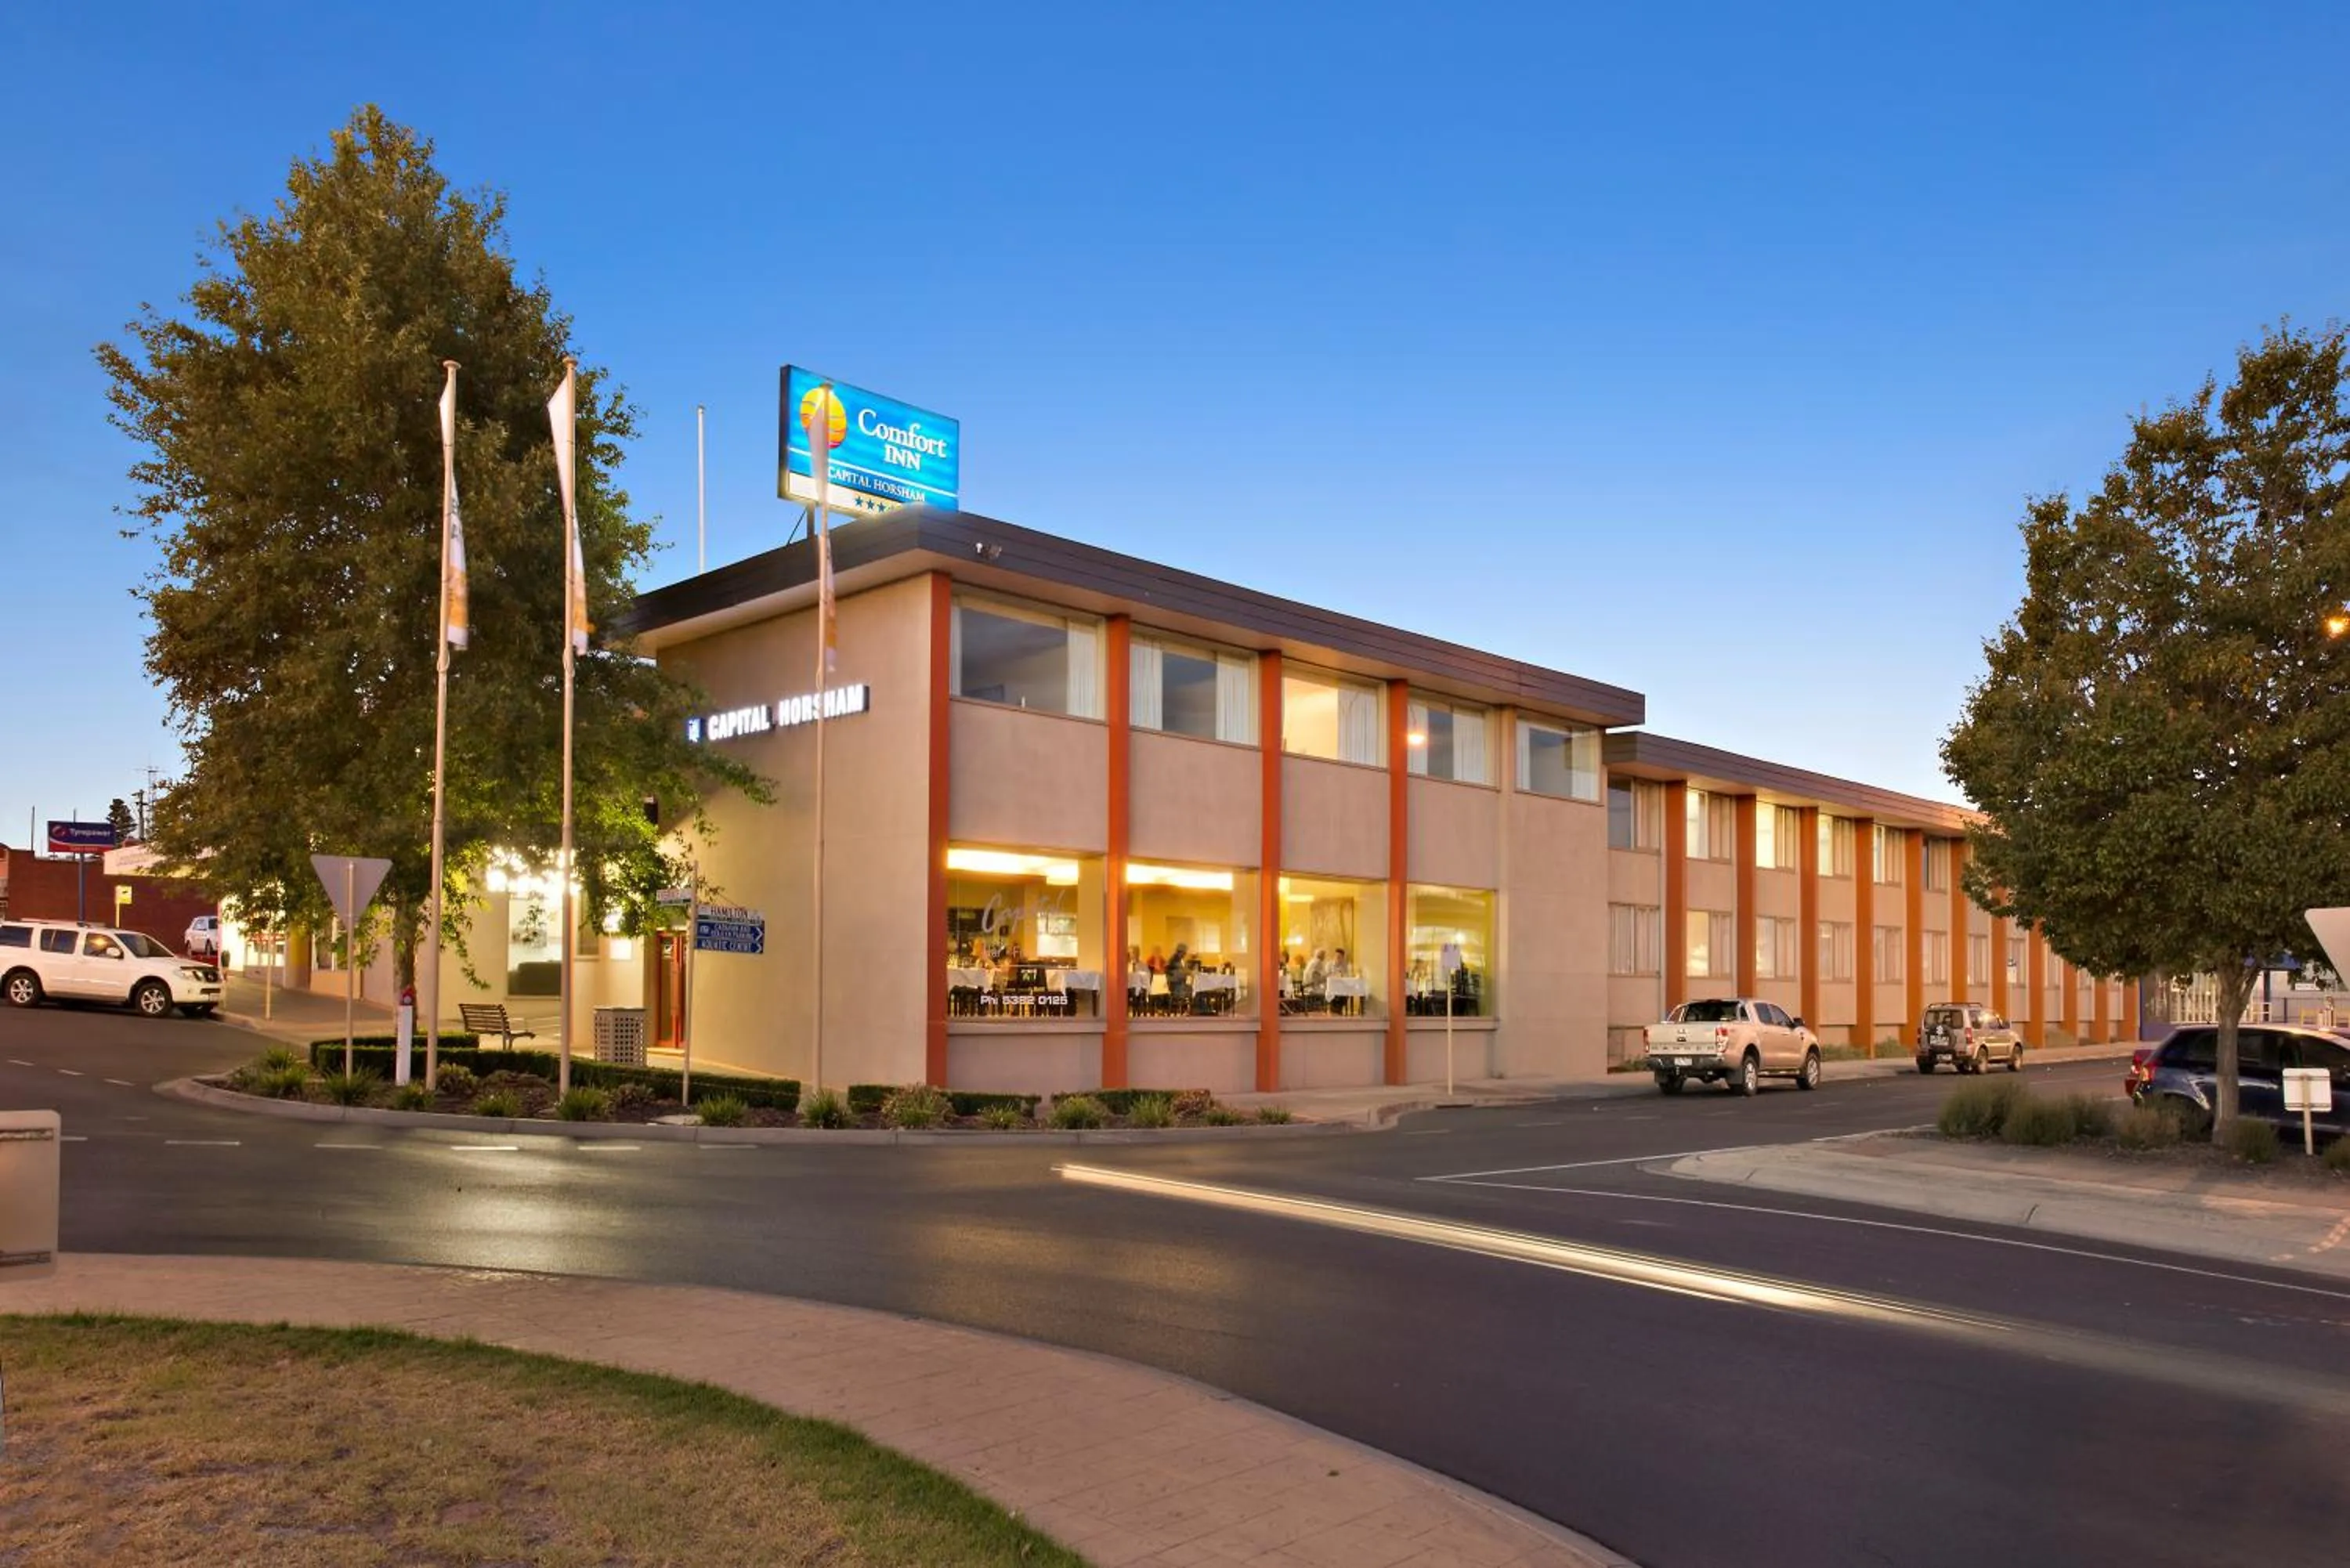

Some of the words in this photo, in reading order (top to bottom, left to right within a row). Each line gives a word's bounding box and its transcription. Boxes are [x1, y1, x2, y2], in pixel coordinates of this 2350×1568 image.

[858, 408, 947, 458] Comfort
[884, 444, 921, 471] INN
[828, 466, 872, 488] CAPITAL
[873, 479, 925, 501] HORSHAM
[707, 704, 771, 741] CAPITAL
[778, 683, 864, 727] HORSHAM
